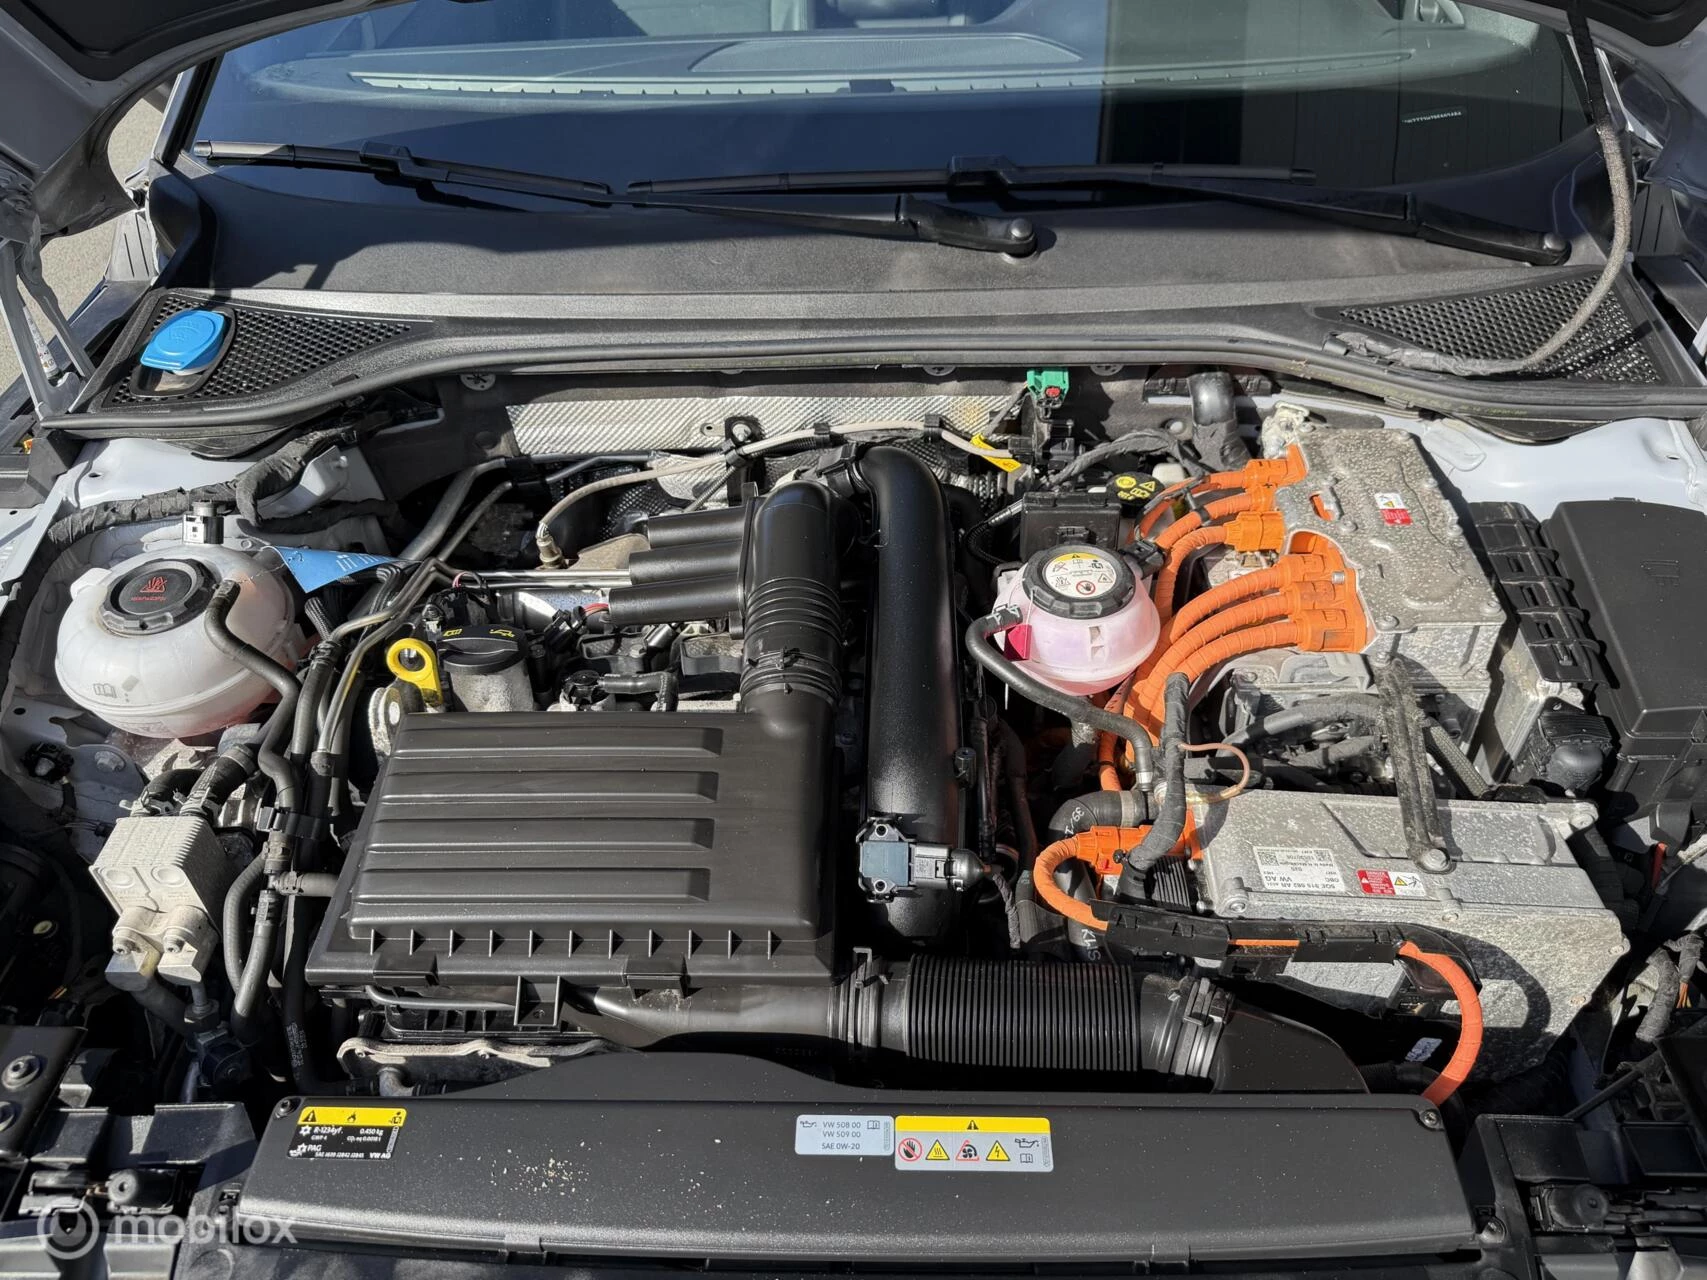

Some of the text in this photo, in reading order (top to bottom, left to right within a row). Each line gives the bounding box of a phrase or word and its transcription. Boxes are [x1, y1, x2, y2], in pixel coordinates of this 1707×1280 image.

[851, 1121, 862, 1129] 00
[836, 1130, 850, 1138] 509
[851, 1130, 861, 1138] 00
[307, 1144, 323, 1152] PAG
[836, 1142, 861, 1150] 0W-20
